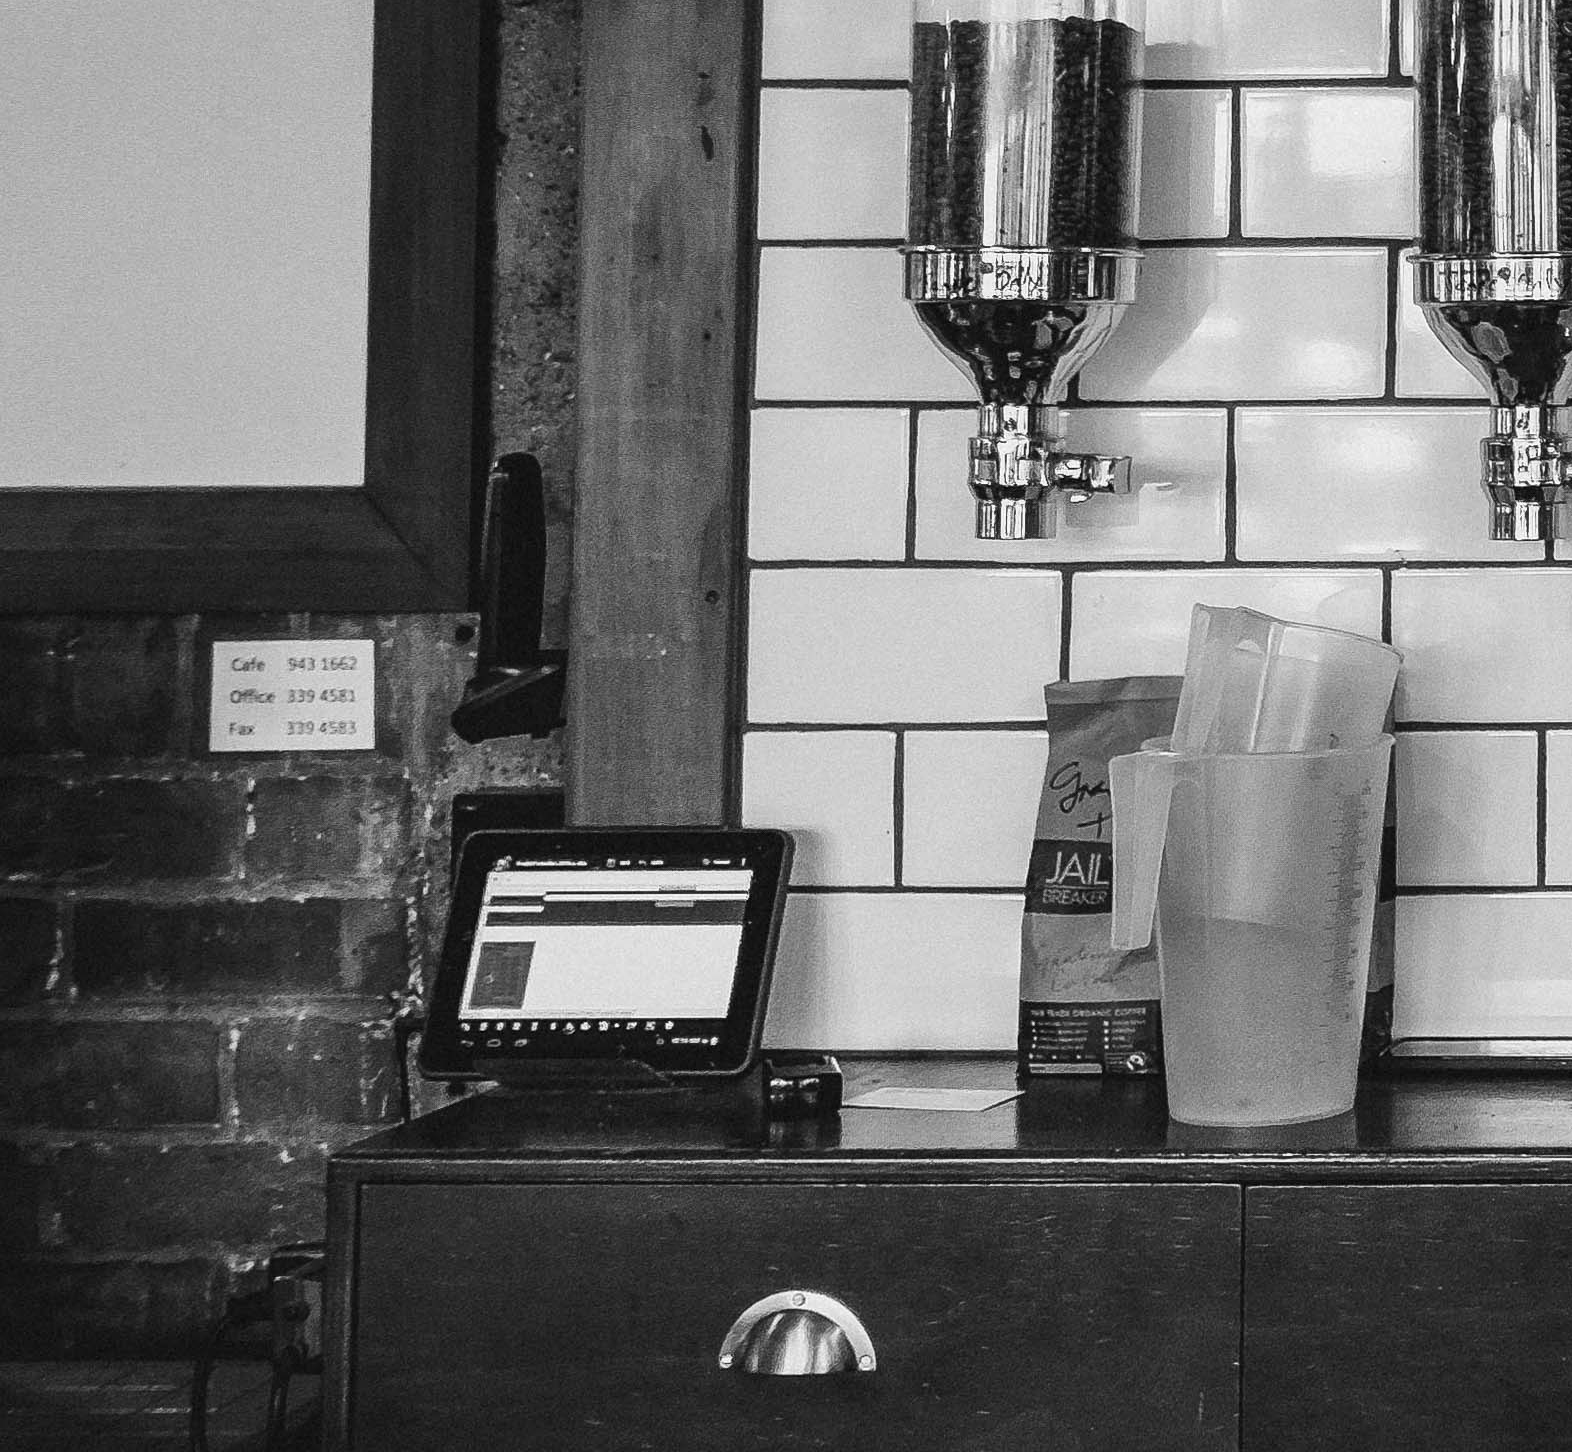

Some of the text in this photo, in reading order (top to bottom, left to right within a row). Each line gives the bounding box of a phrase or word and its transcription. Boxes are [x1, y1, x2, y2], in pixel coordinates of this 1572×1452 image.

[231, 656, 266, 672] Cafe
[288, 657, 315, 671] 943
[230, 688, 355, 703] Office 339 4581
[229, 722, 256, 736] Fax
[287, 721, 314, 735] 339
[1046, 852, 1110, 886] JAIL
[1042, 888, 1108, 905] BREAKER
